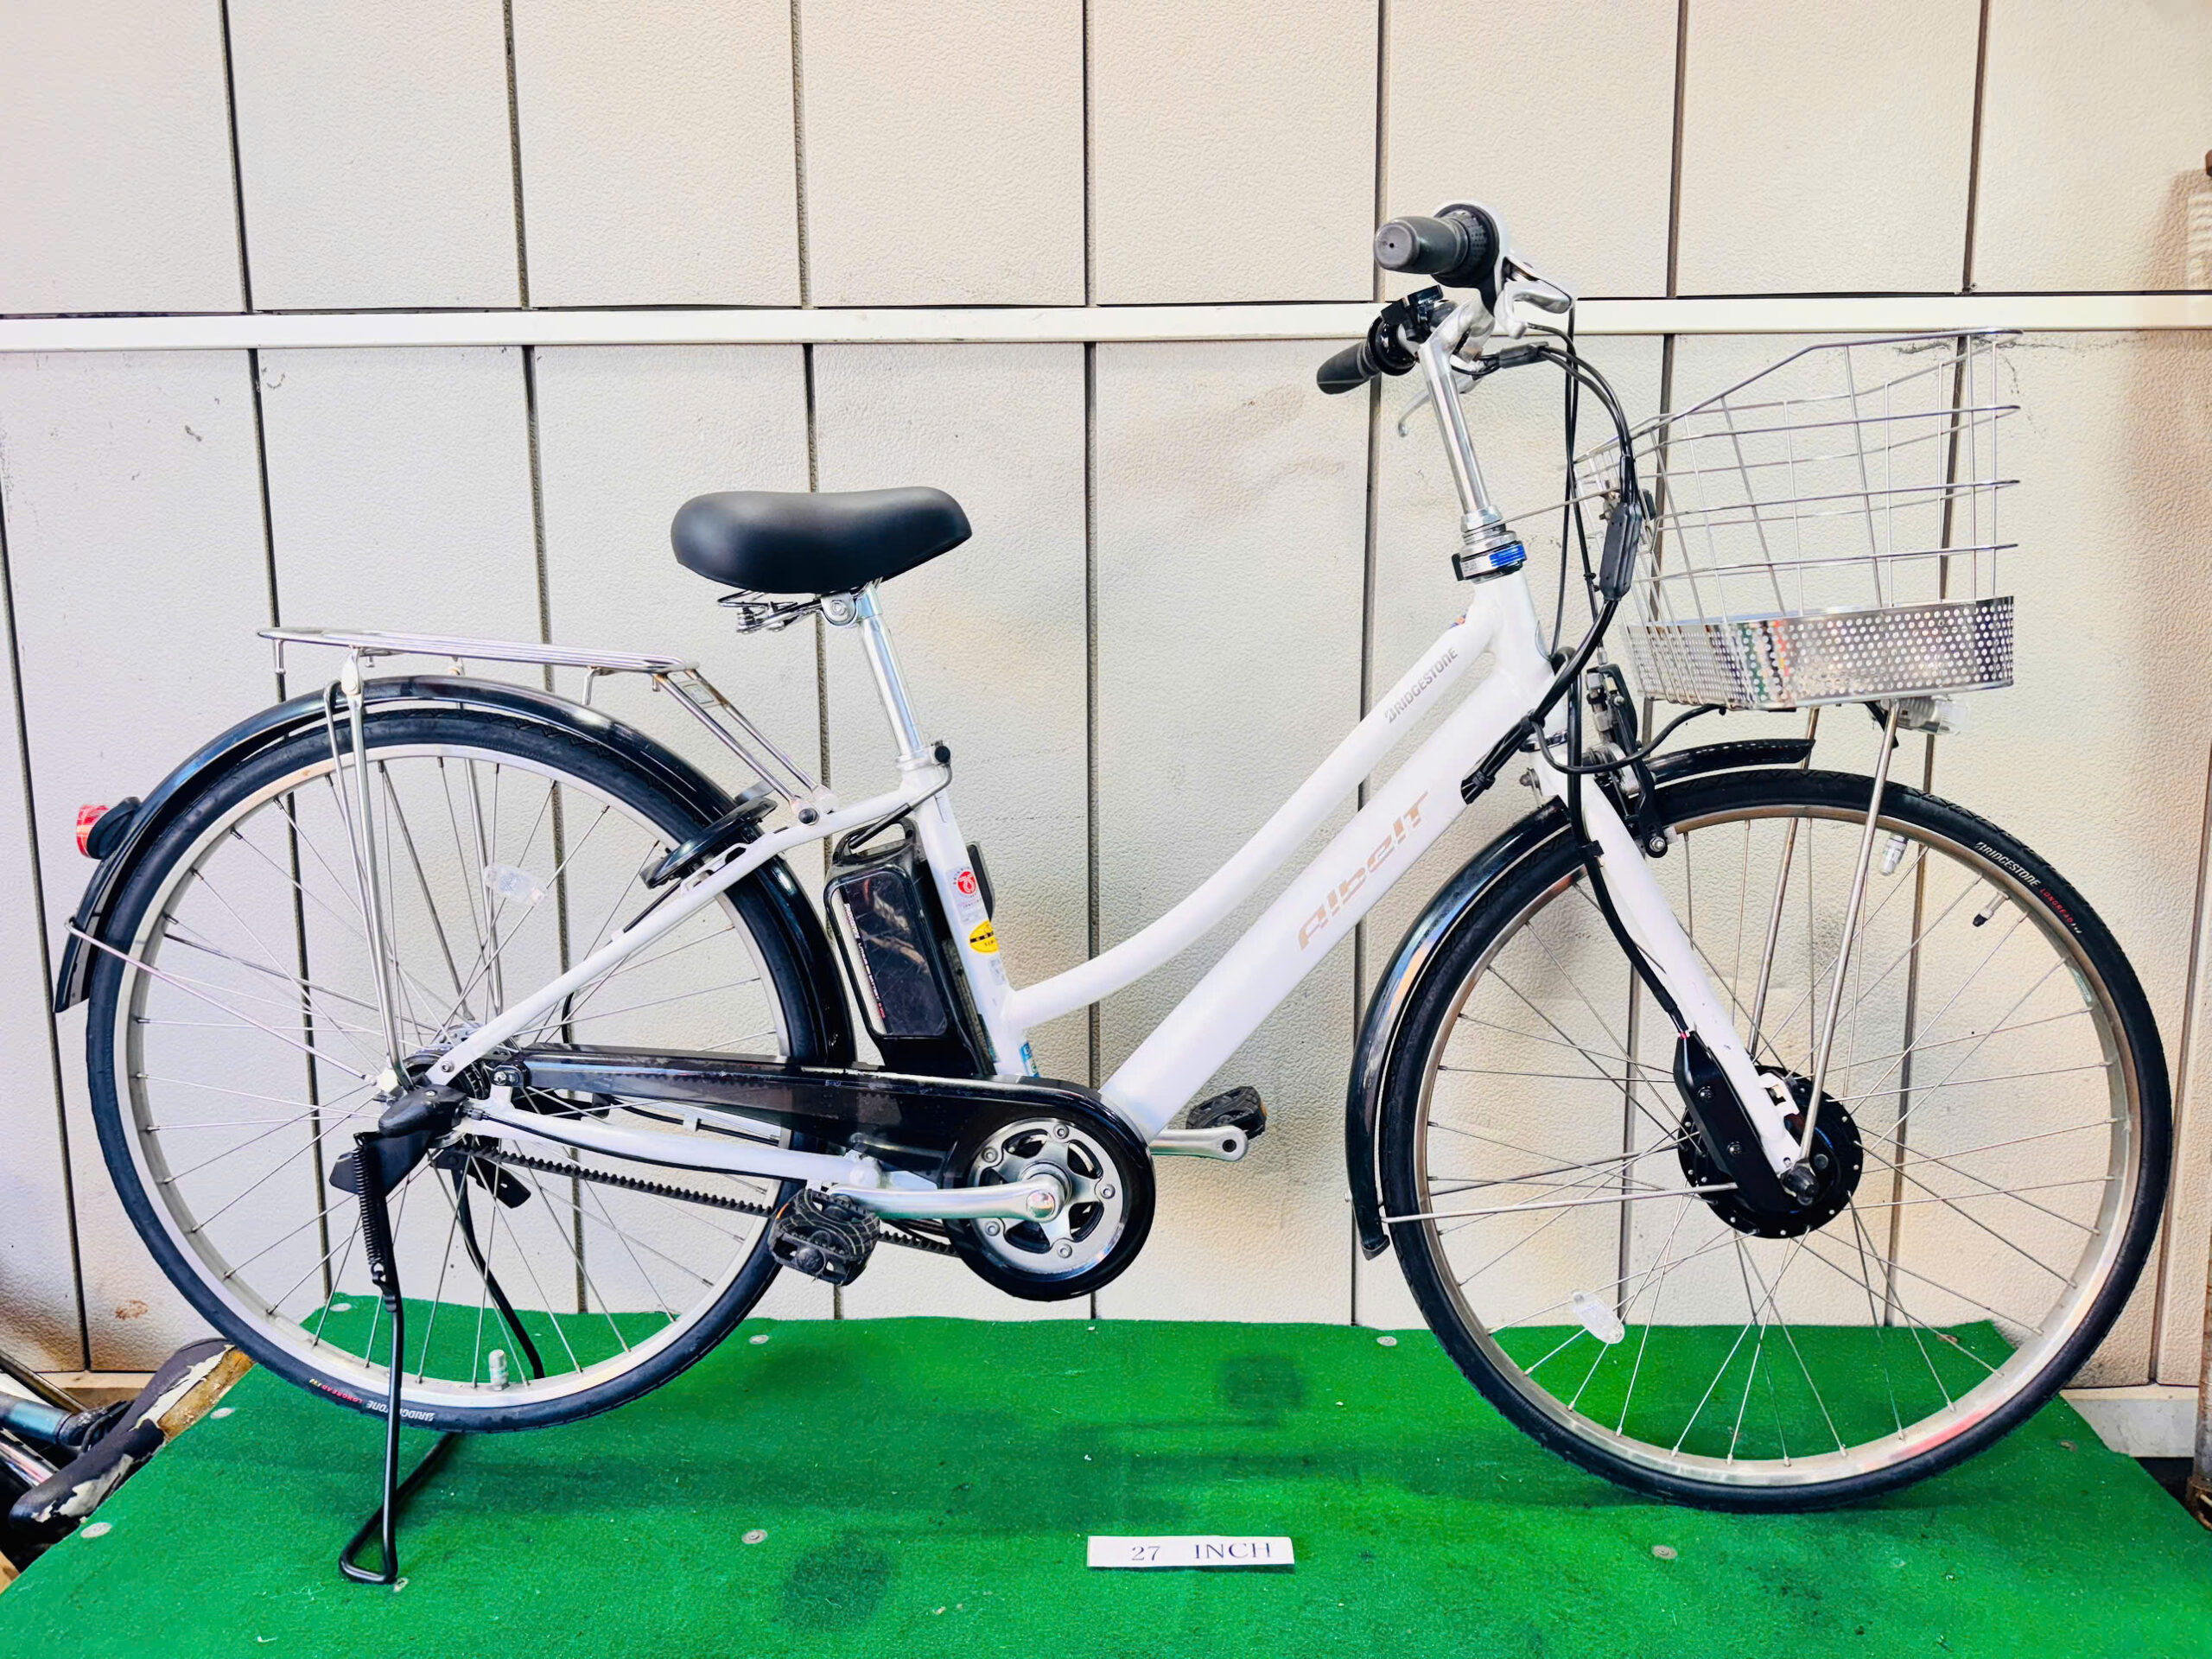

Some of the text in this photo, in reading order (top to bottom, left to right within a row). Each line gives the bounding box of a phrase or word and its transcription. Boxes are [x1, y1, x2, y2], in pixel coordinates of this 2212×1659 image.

[1384, 646, 1458, 724] BRIDGESTONE
[1975, 842, 2041, 887] BRIDGESTONE
[1131, 1542, 1272, 1561] 27 INCH
